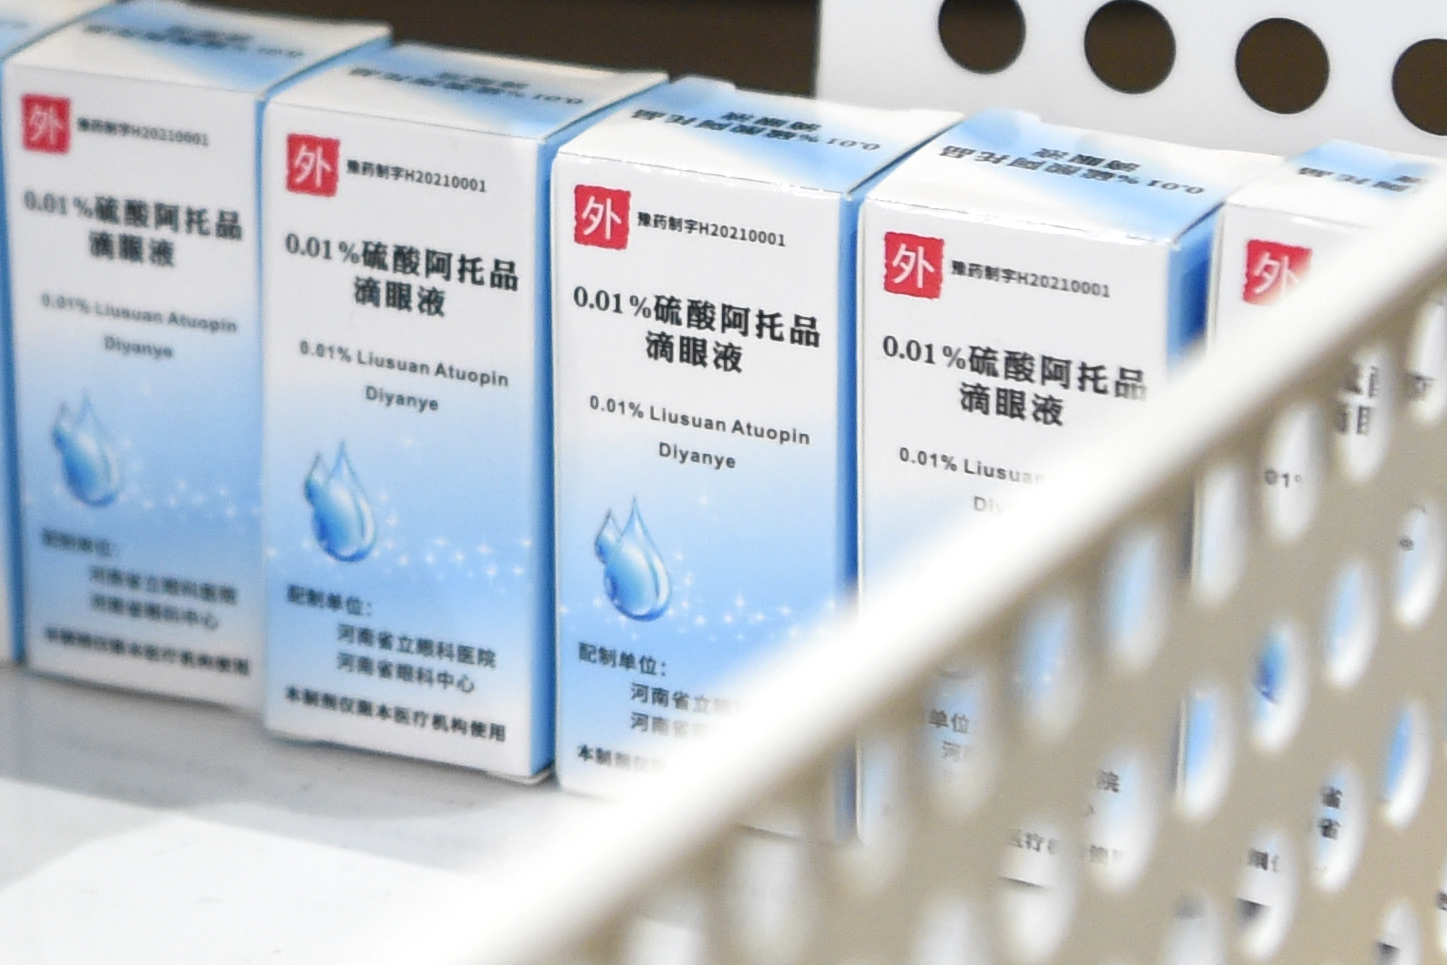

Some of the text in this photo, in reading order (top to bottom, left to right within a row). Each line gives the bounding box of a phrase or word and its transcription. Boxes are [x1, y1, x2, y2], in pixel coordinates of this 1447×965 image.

[637, 211, 786, 247] 豫药制字H20210001
[285, 232, 520, 292] 0.01%硫酸阿托品
[951, 260, 1111, 299] 豫药制字H20210001
[353, 275, 446, 318] 滴眼液
[573, 285, 821, 348] 0.01%硫酸阿托品
[299, 340, 509, 387] 0.01% Liusuan Atuopin
[645, 330, 743, 374] 滴眼液
[882, 334, 1147, 402] 0.01%硫酸阿托品
[365, 385, 439, 413] Diyanye
[589, 394, 811, 446] 0.01% Liusuan Atuopin
[959, 381, 1064, 427] 滴眼液
[659, 441, 737, 469] Diyanye
[899, 446, 957, 472] 0.01%
[337, 622, 497, 669] 河南省立眼科医院
[337, 651, 475, 695] 河南省眼科中心
